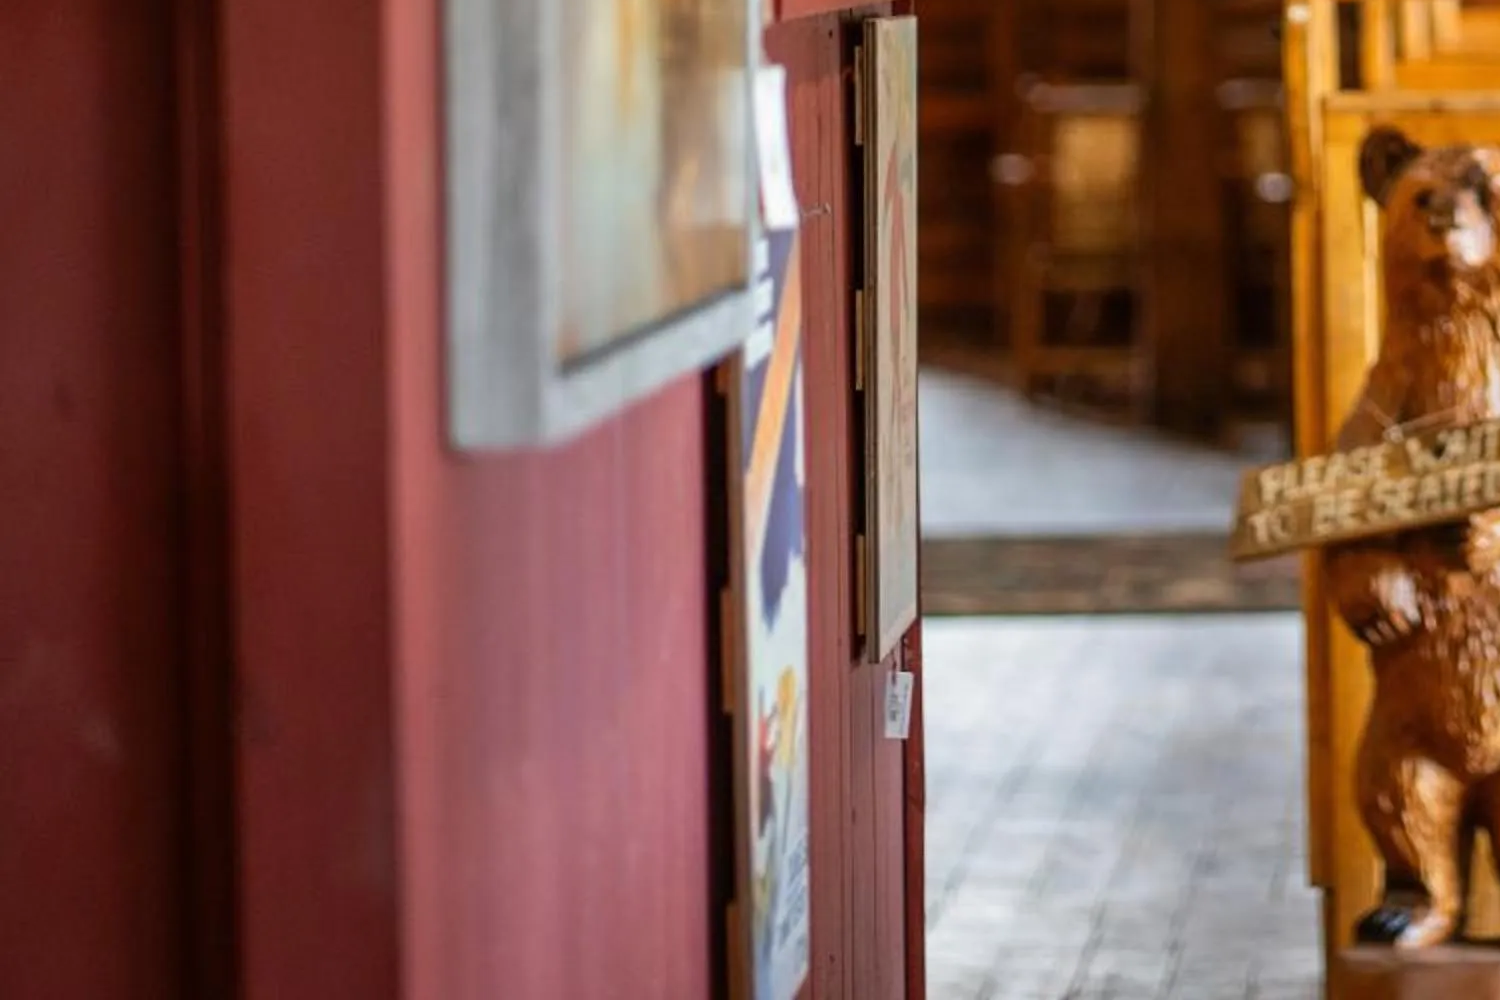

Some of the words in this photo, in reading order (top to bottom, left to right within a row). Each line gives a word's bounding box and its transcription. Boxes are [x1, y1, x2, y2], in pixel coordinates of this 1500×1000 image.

[1259, 444, 1392, 505] PLEASE
[1406, 422, 1499, 471] WAIT
[1248, 507, 1294, 544] TO
[1312, 487, 1365, 536] BE
